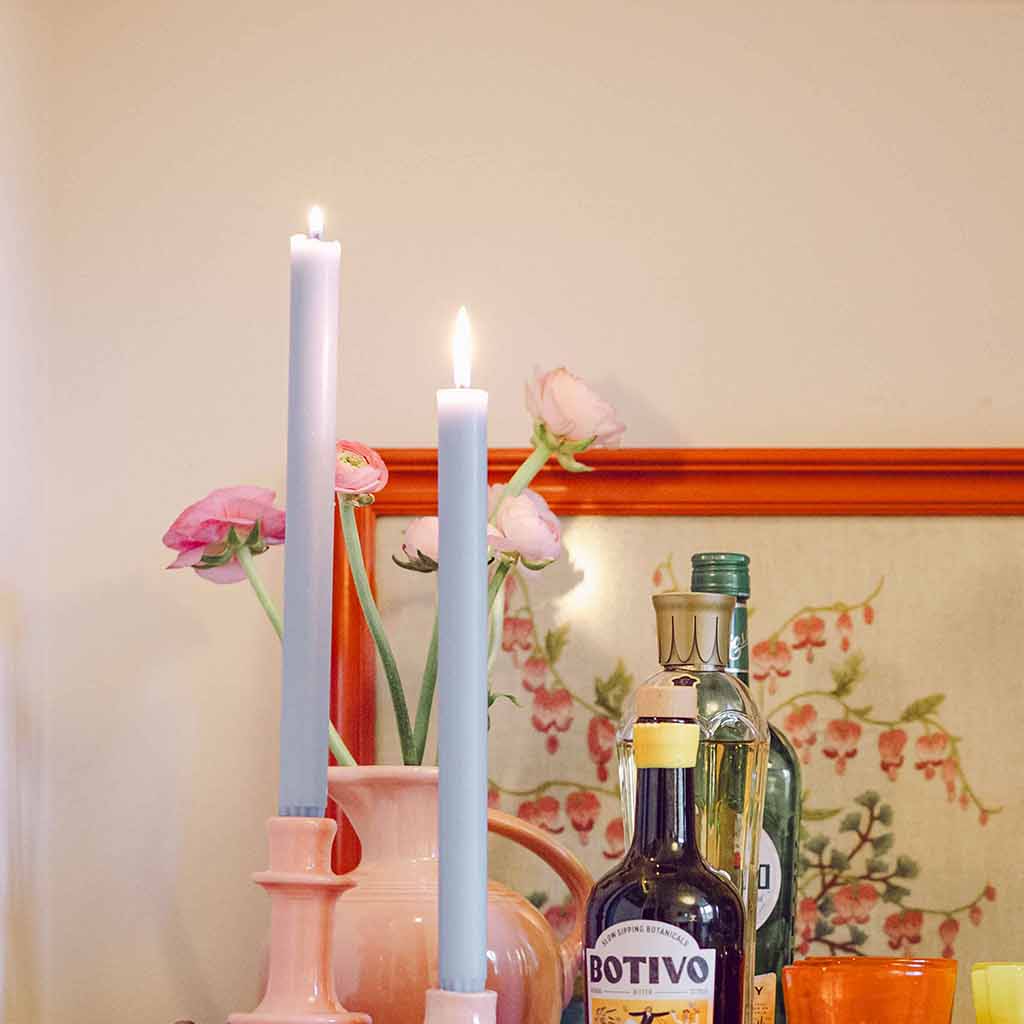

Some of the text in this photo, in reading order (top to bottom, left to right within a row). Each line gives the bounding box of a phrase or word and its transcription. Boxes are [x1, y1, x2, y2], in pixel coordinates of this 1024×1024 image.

[617, 925, 644, 936] SIPPING
[646, 926, 689, 946] BOTANICALS
[590, 955, 709, 984] BOTIVO
